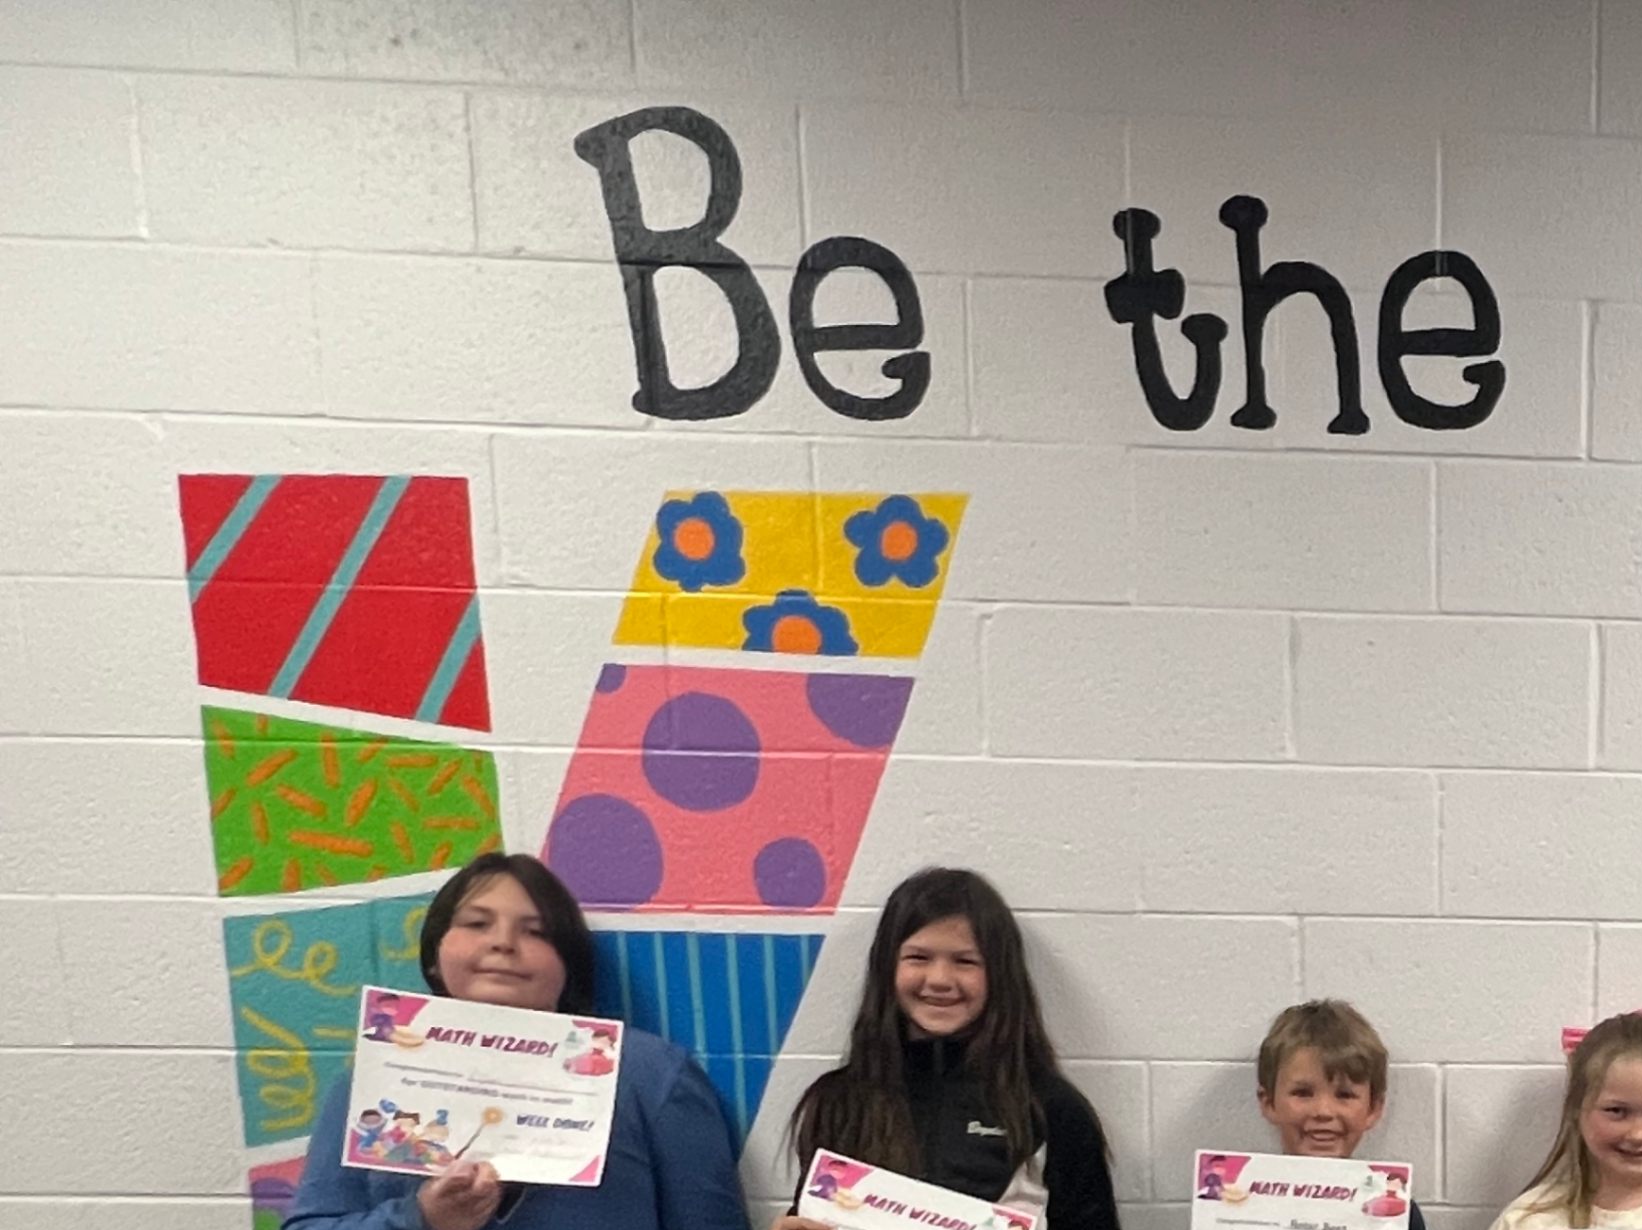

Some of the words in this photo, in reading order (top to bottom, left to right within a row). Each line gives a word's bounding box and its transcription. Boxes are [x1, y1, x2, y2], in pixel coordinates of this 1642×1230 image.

[573, 105, 931, 421] Be
[1104, 193, 1506, 435] the
[425, 1026, 477, 1046] MATH
[479, 1033, 559, 1058] WIZARD!
[863, 1193, 908, 1216] MATH
[1249, 1180, 1290, 1197] MATH
[1293, 1184, 1358, 1202] WIZARD!
